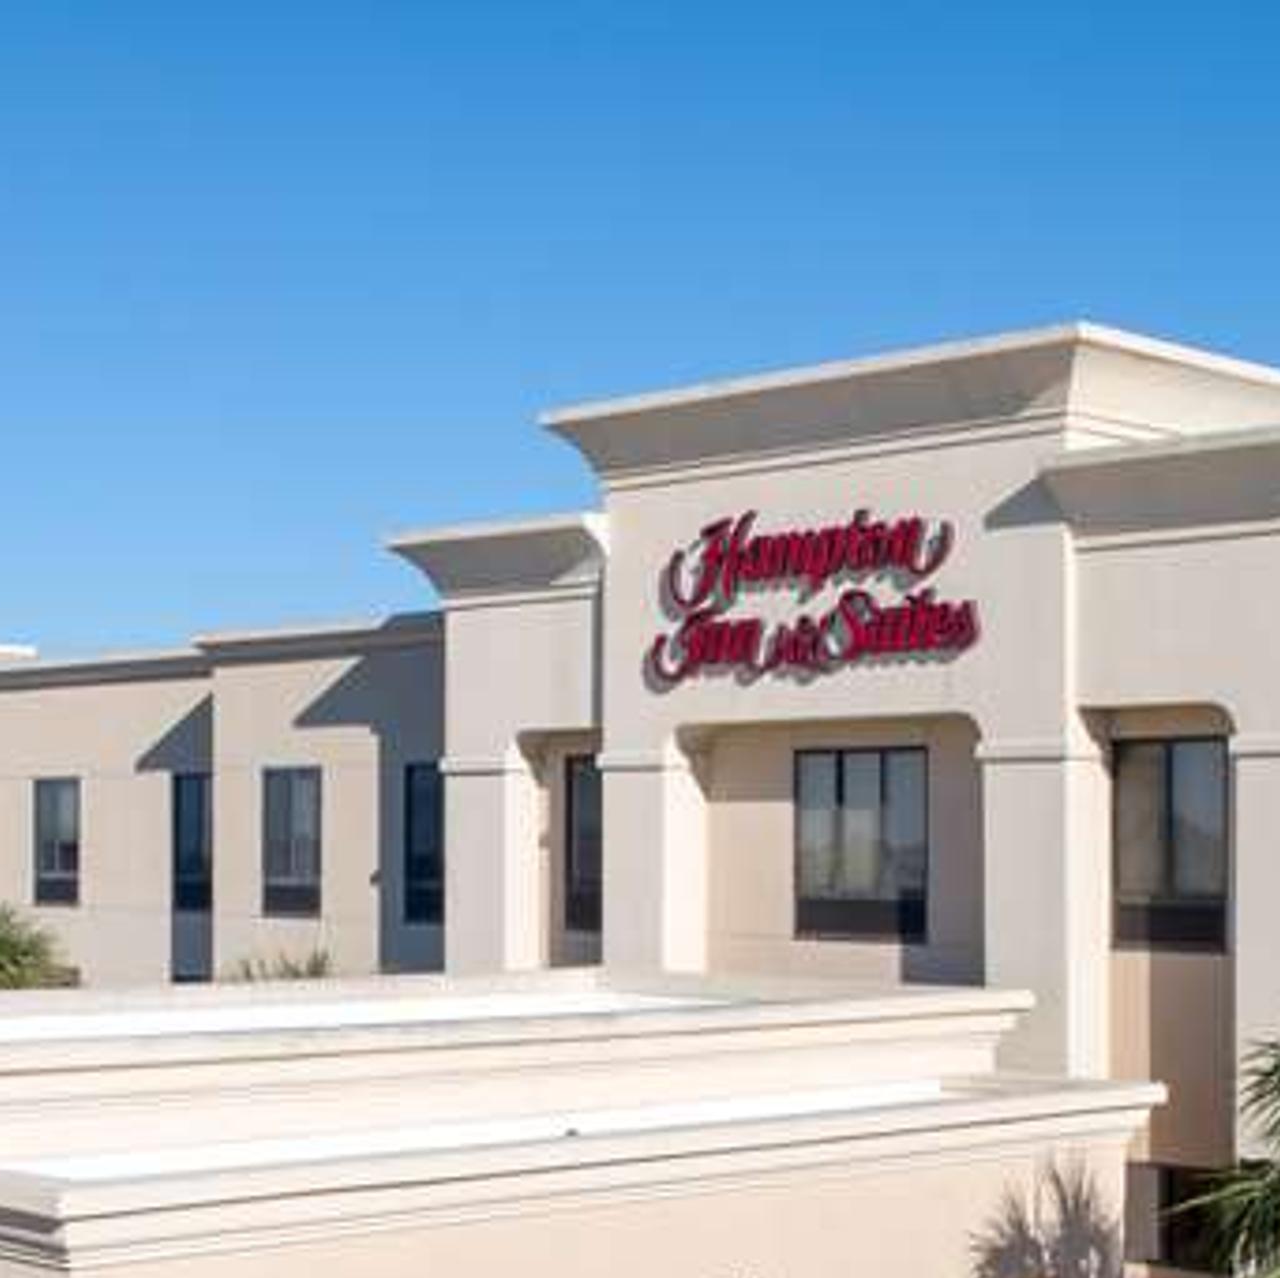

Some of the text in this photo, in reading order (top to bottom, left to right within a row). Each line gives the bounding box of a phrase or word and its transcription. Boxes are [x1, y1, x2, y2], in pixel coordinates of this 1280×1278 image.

[662, 509, 954, 610] Hampton
[648, 608, 776, 682] Inn
[822, 588, 980, 662] Suites
